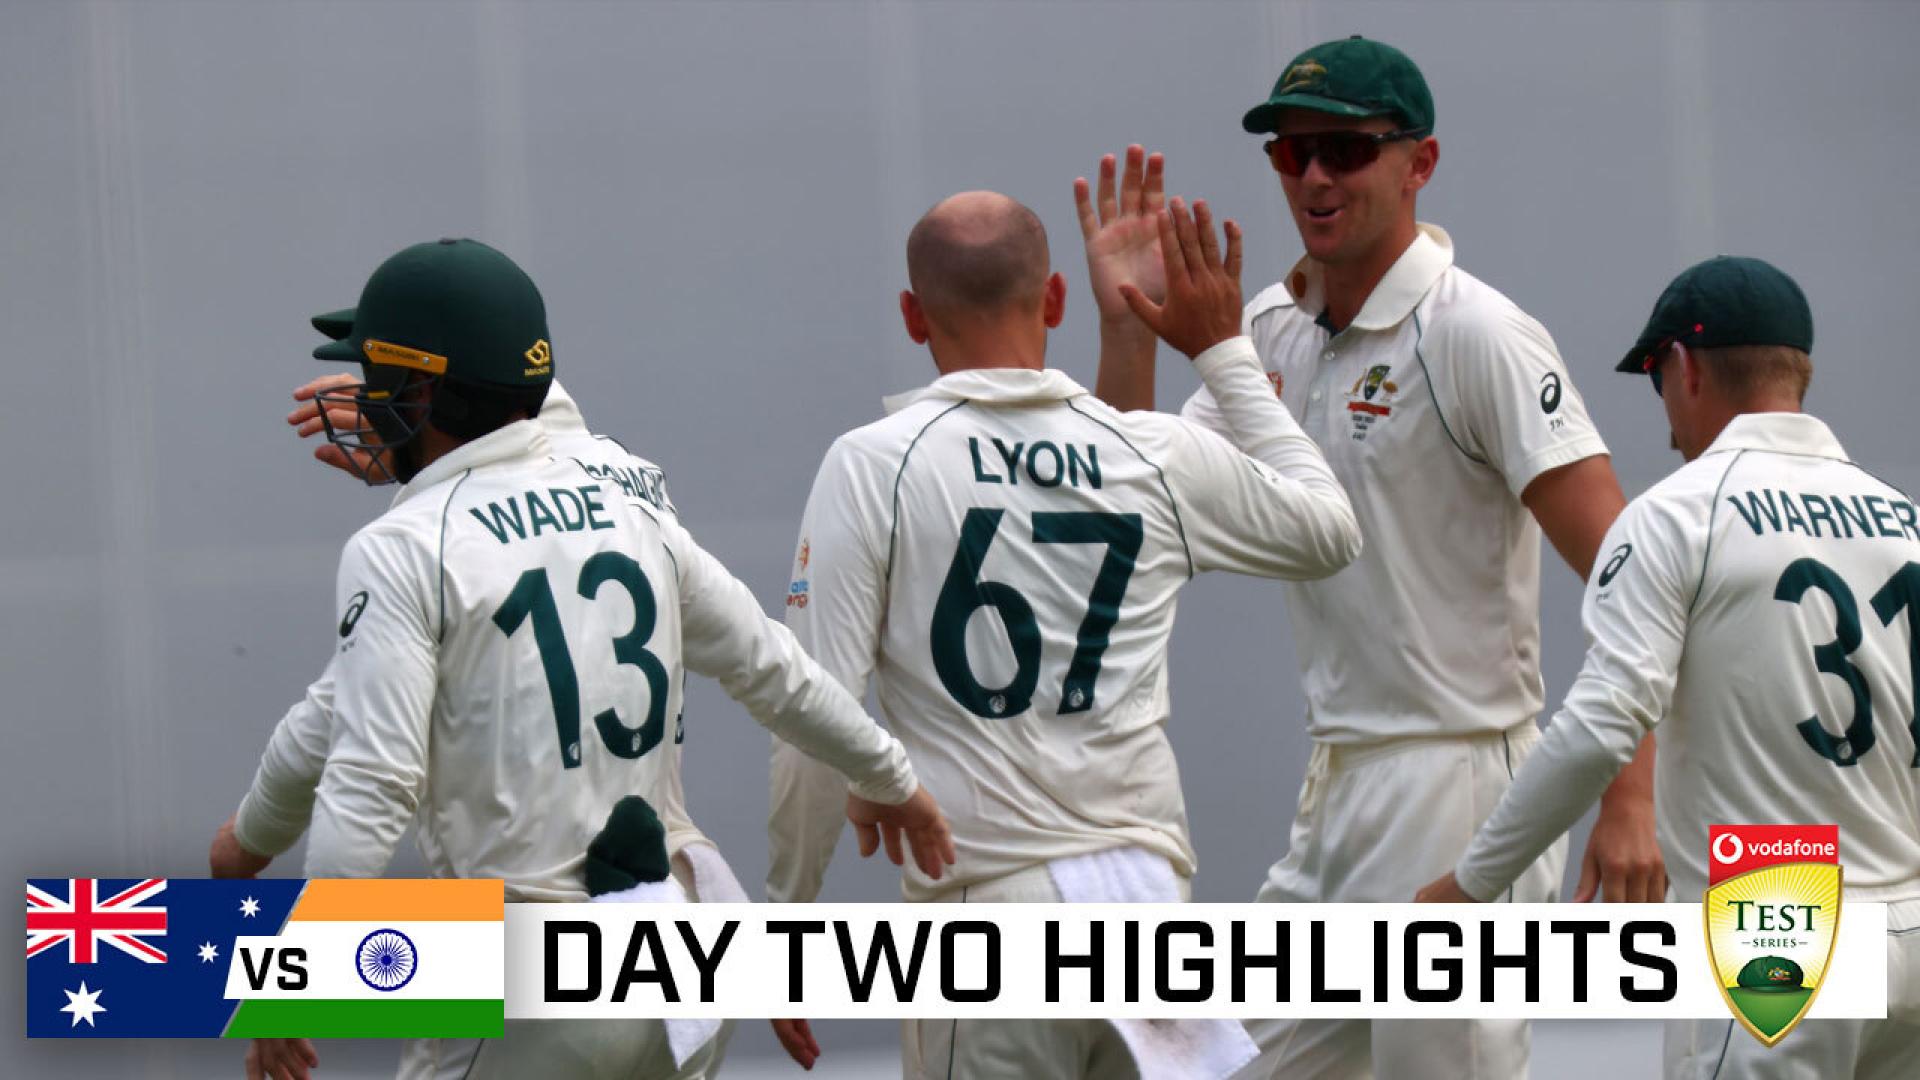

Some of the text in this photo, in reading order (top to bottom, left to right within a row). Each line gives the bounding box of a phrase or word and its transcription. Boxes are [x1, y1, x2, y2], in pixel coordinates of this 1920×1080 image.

[469, 484, 616, 544] WADE
[968, 437, 1103, 490] LYON
[1727, 489, 1920, 541] WARNER
[491, 550, 671, 770] 13
[929, 507, 1144, 720] 67
[1772, 557, 1920, 770] 31
